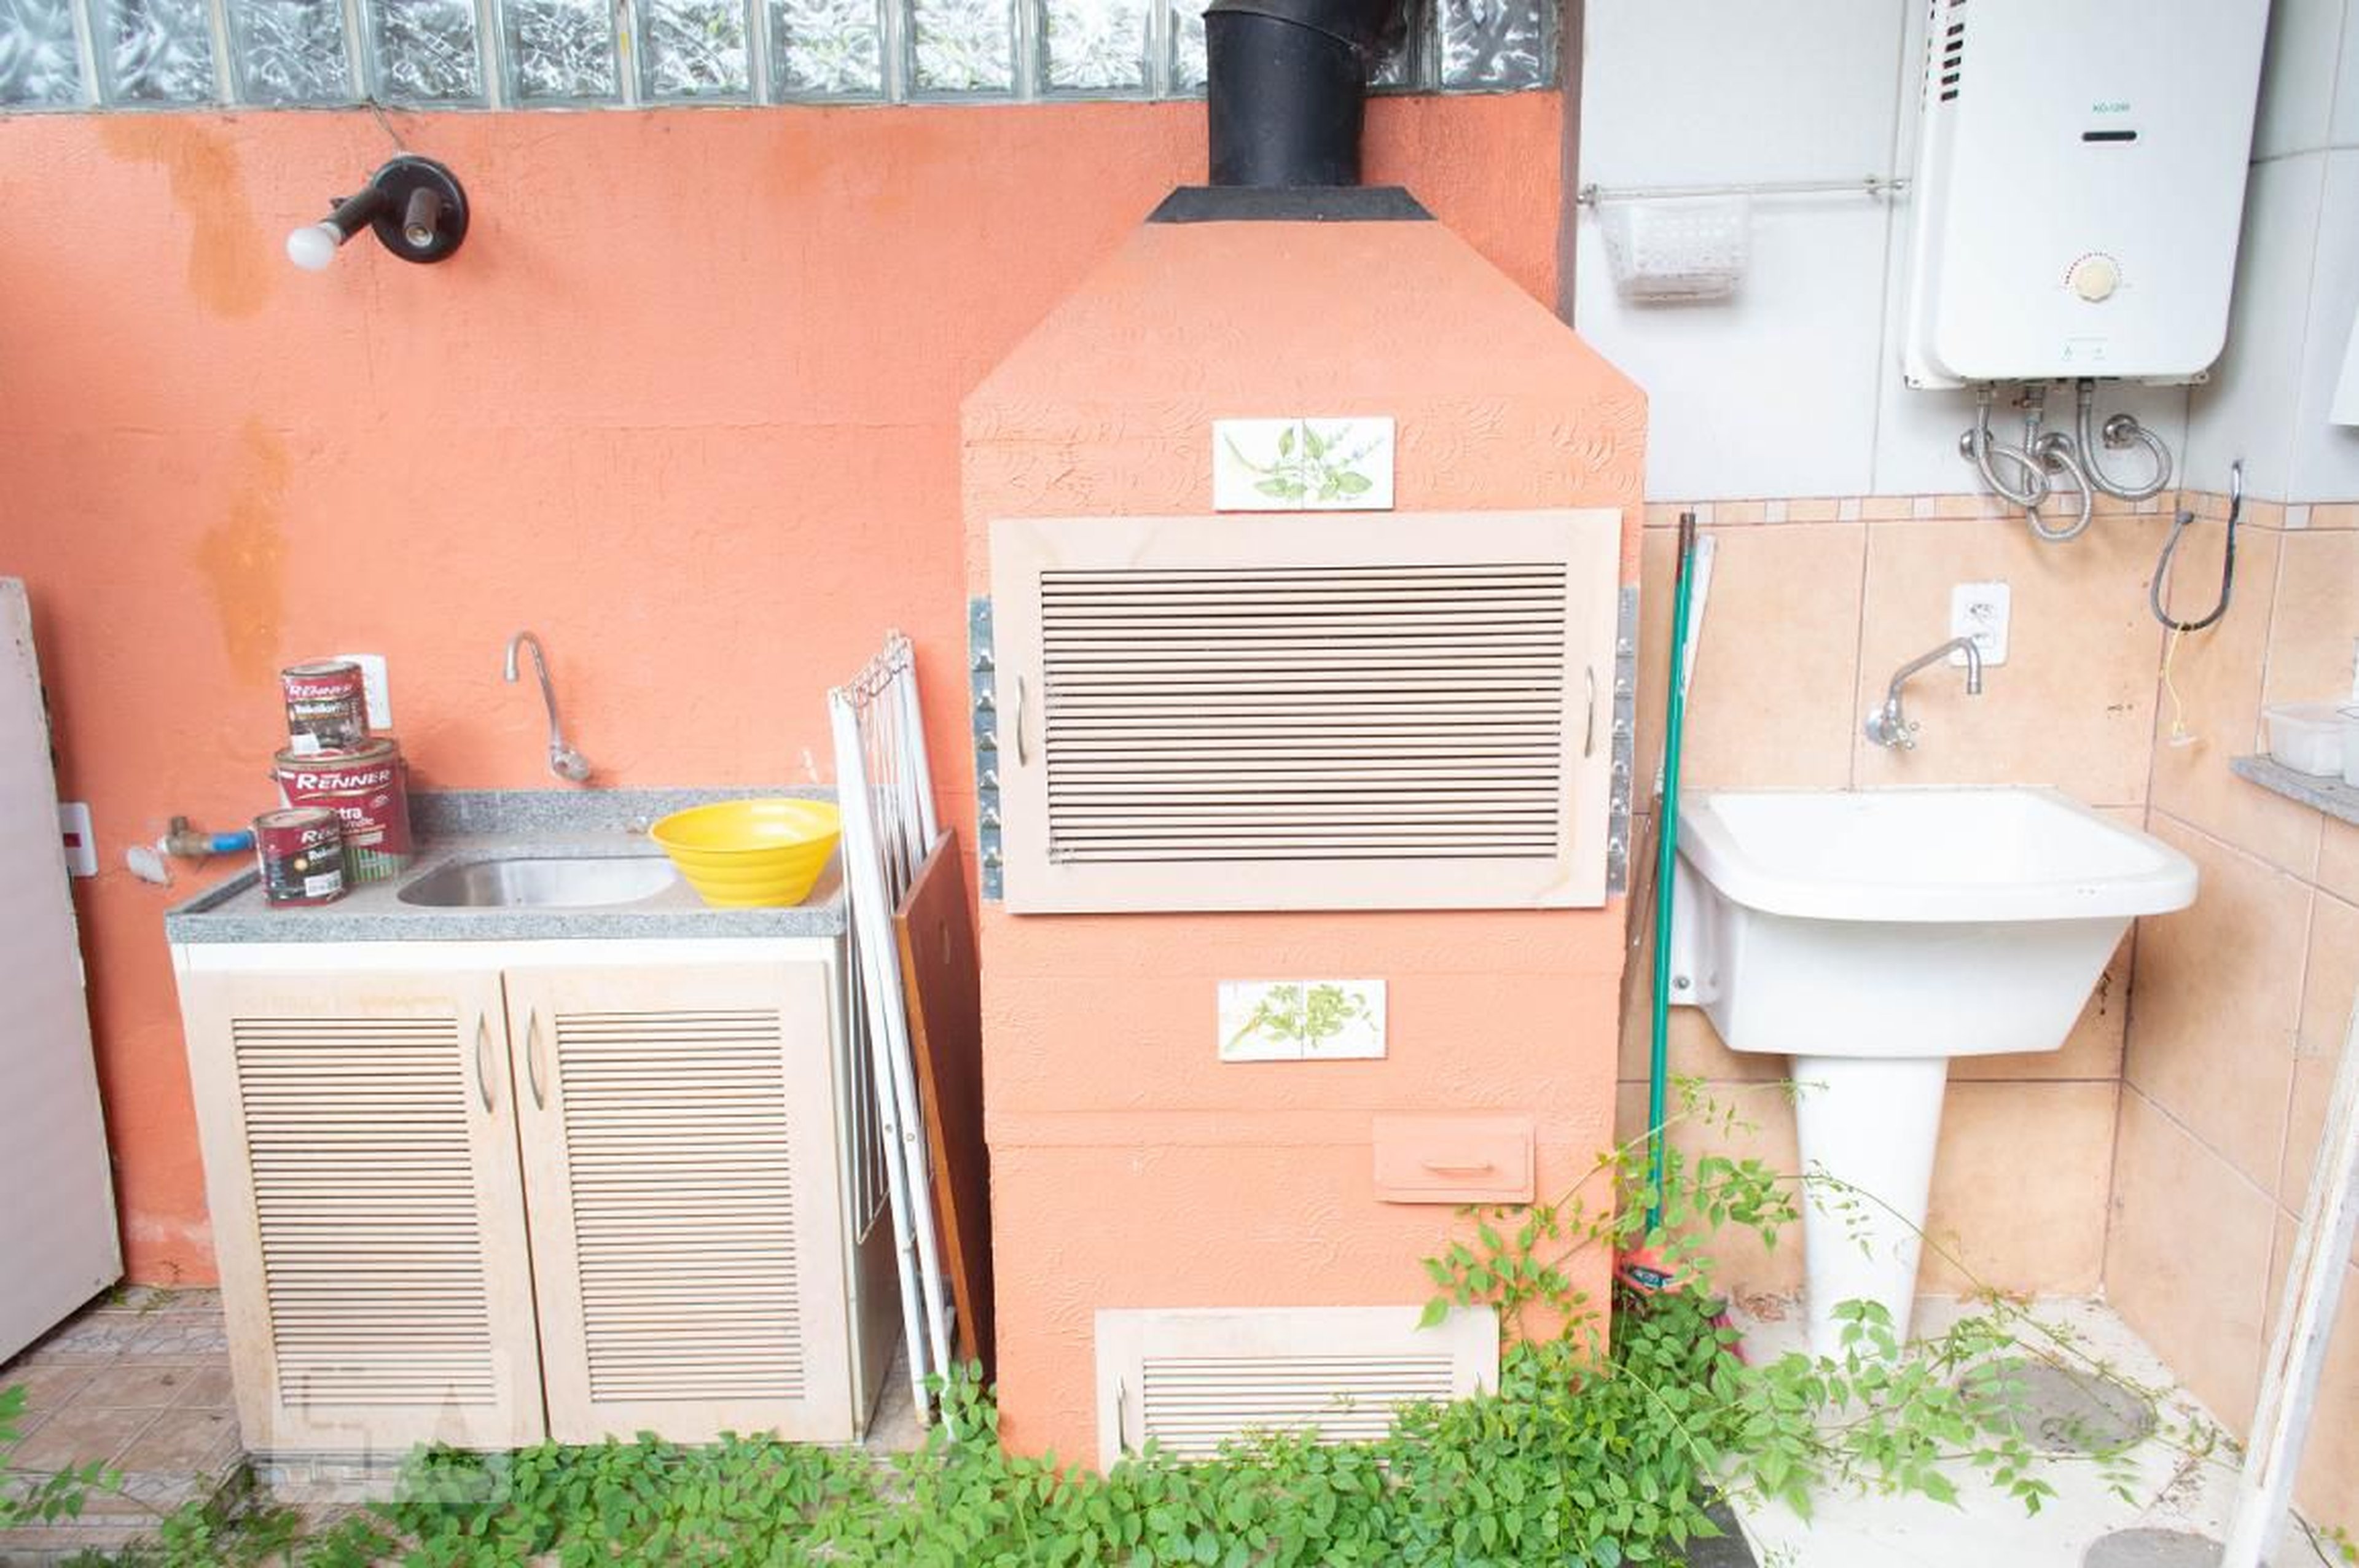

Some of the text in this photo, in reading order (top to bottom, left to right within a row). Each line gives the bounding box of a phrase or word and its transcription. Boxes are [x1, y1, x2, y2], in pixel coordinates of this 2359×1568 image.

[289, 684, 352, 696] RENNER
[297, 769, 391, 789] RENNER
[337, 806, 362, 820] tra
